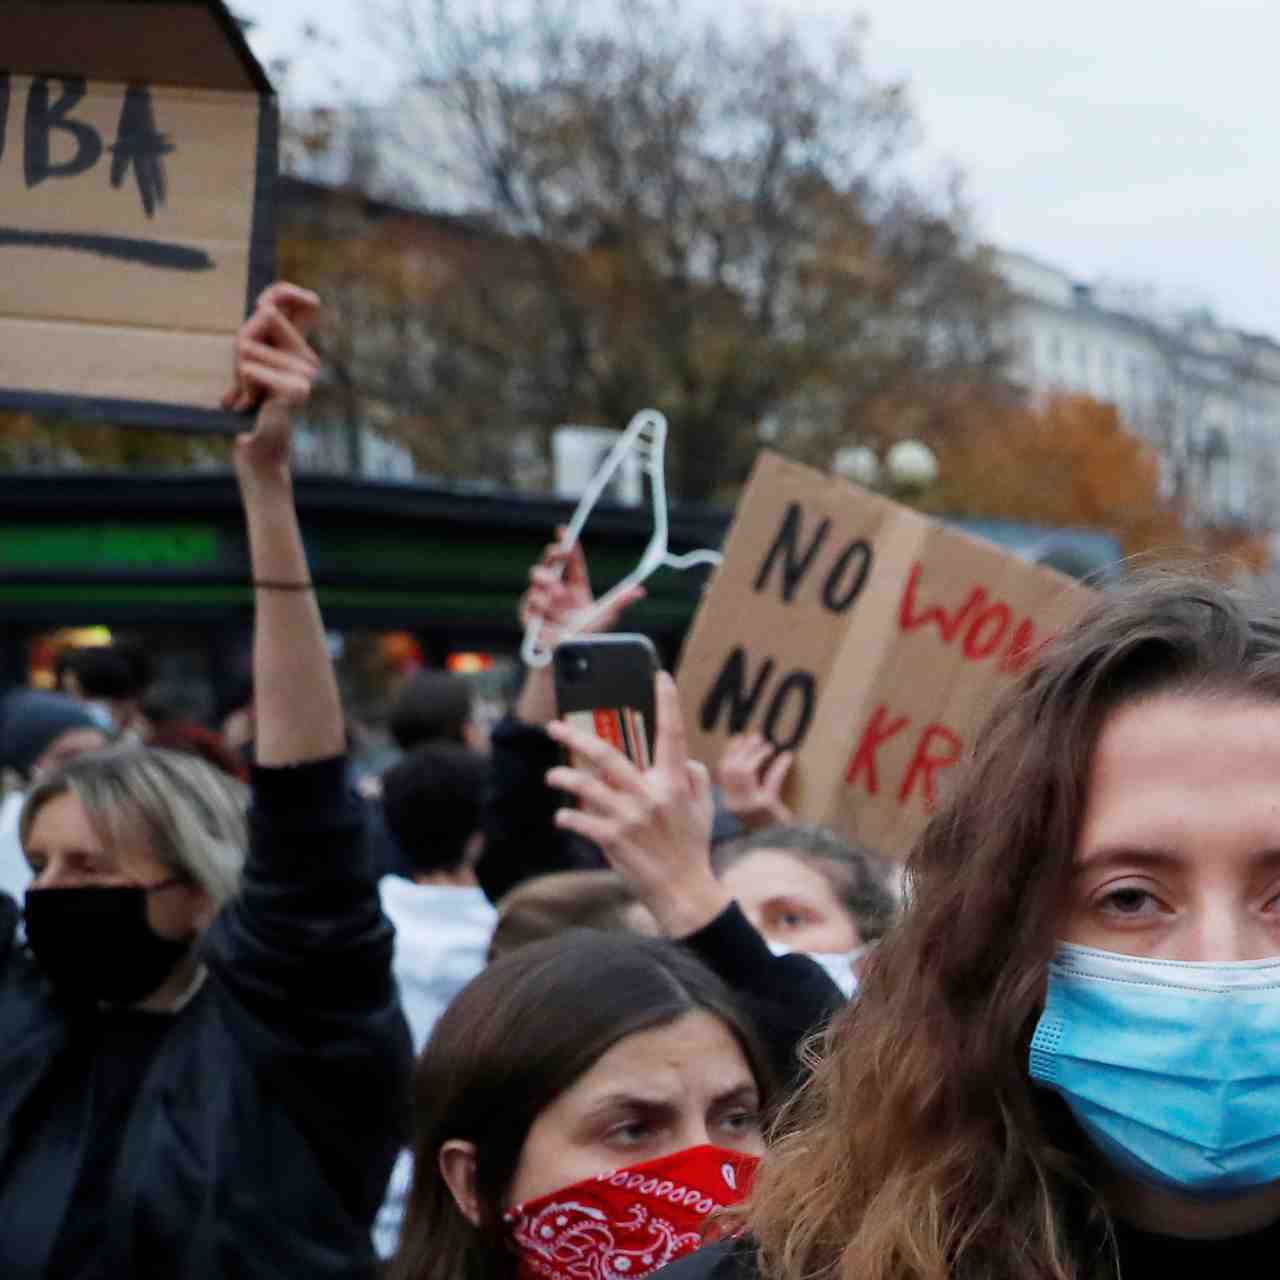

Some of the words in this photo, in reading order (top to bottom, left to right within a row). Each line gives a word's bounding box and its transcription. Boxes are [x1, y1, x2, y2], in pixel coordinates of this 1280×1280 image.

[0, 78, 176, 218] BA
[754, 503, 873, 615] NO
[701, 645, 817, 754] NO
